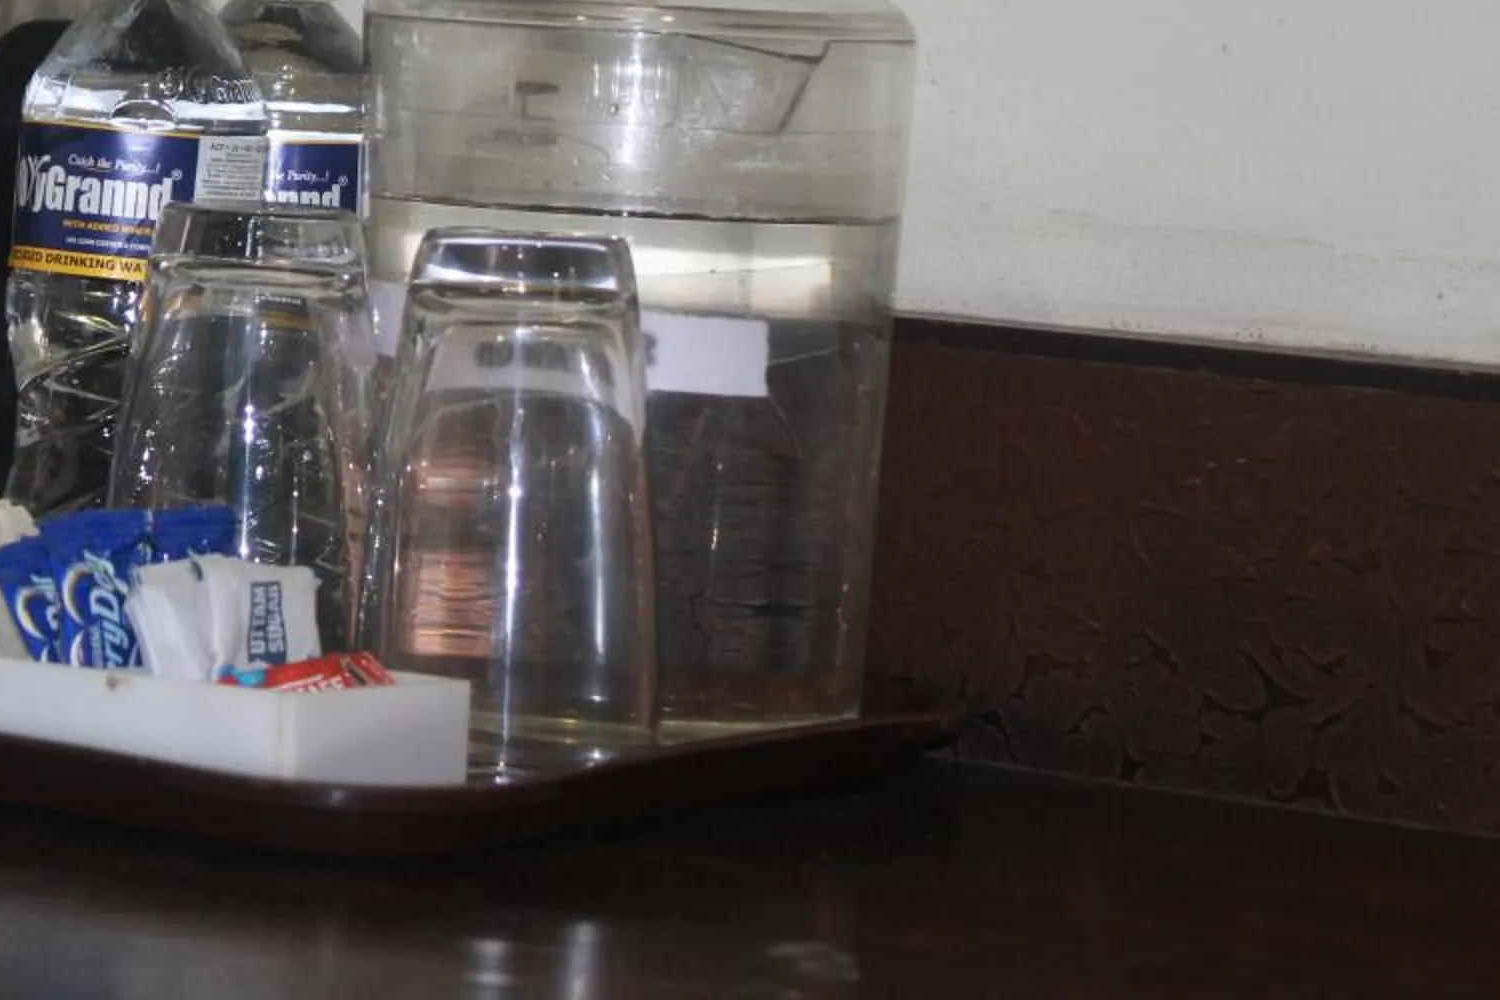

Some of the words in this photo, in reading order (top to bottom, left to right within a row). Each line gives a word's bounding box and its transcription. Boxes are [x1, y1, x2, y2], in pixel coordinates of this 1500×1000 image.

[45, 252, 116, 271] DRINKING
[250, 584, 266, 655] UTTAM
[266, 583, 285, 654] SUGAR
